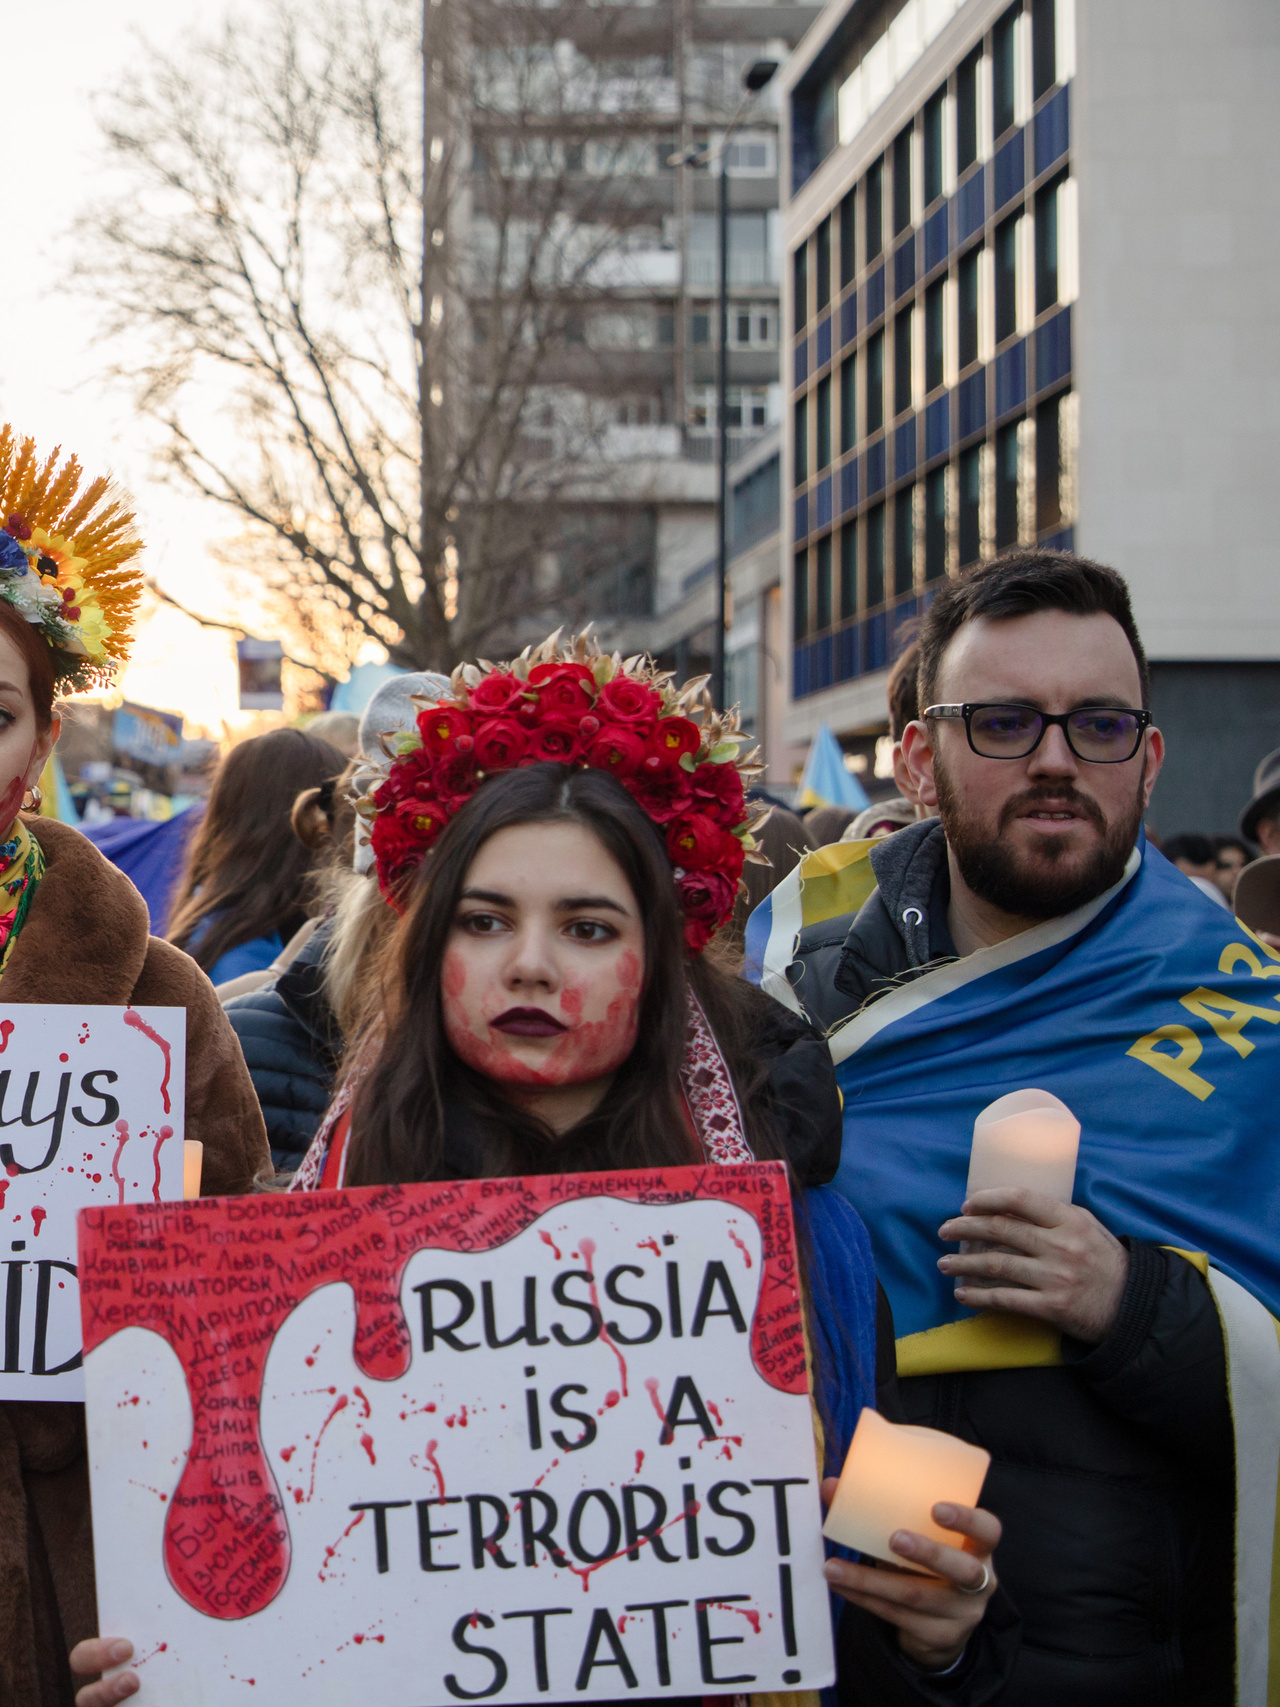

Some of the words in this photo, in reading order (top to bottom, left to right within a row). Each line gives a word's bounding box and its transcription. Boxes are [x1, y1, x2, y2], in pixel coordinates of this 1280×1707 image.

[1125, 917, 1280, 1102] РАЗ
[412, 1234, 748, 1353] RUSSIA
[659, 1375, 716, 1446] A
[349, 1456, 810, 1573] TERRORIST
[443, 1563, 802, 1700] STATE!
